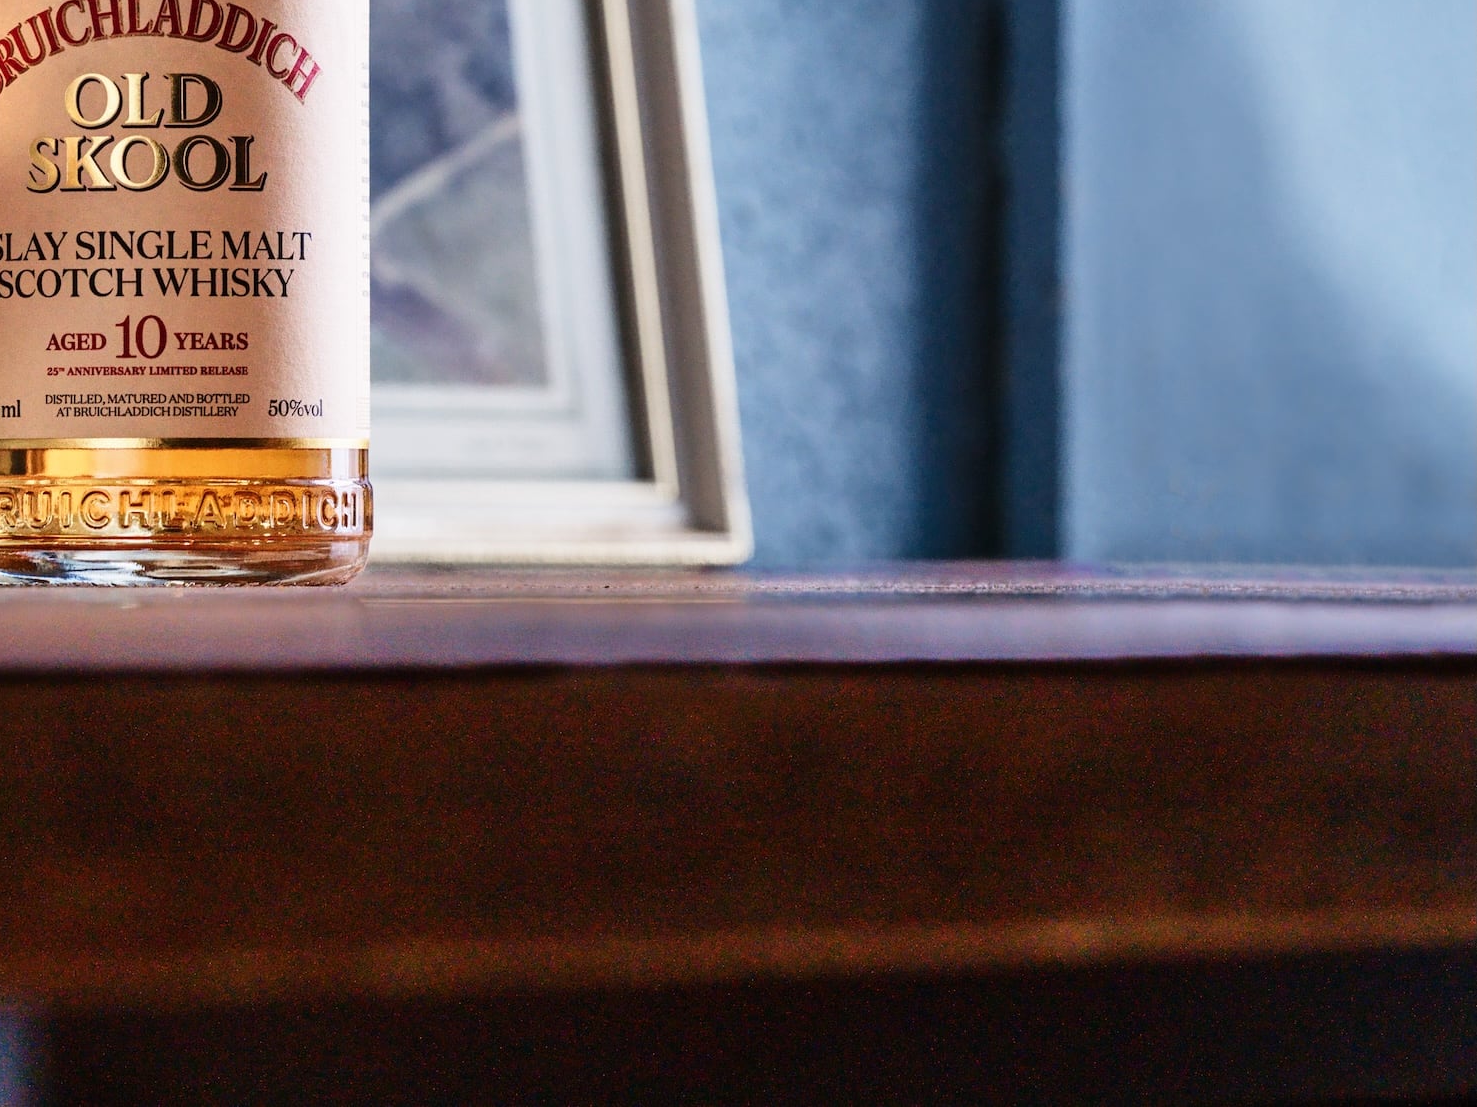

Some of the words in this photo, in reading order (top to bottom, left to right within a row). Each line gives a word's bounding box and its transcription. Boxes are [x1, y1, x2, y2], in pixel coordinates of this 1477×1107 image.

[64, 72, 222, 129] OLD
[26, 134, 267, 193] SKOOL
[75, 230, 212, 261] SINGLE
[222, 231, 312, 261] MALT
[152, 269, 295, 299] WHISKY
[46, 333, 106, 351] AGED
[115, 314, 167, 359] 10
[174, 332, 249, 351] YEARS
[67, 366, 147, 376] ANNIVERSARY
[149, 366, 198, 376] LIMITED
[200, 366, 249, 376] RELEASE
[1, 400, 21, 418] ml
[45, 394, 106, 406] DISTILLED,
[107, 394, 167, 404] MATURED
[169, 394, 194, 404] AND
[196, 393, 250, 404] BOTTLED
[56, 406, 72, 418] AT
[73, 406, 171, 418] BRUICHLADDICH
[173, 406, 239, 417] DISTILLERY
